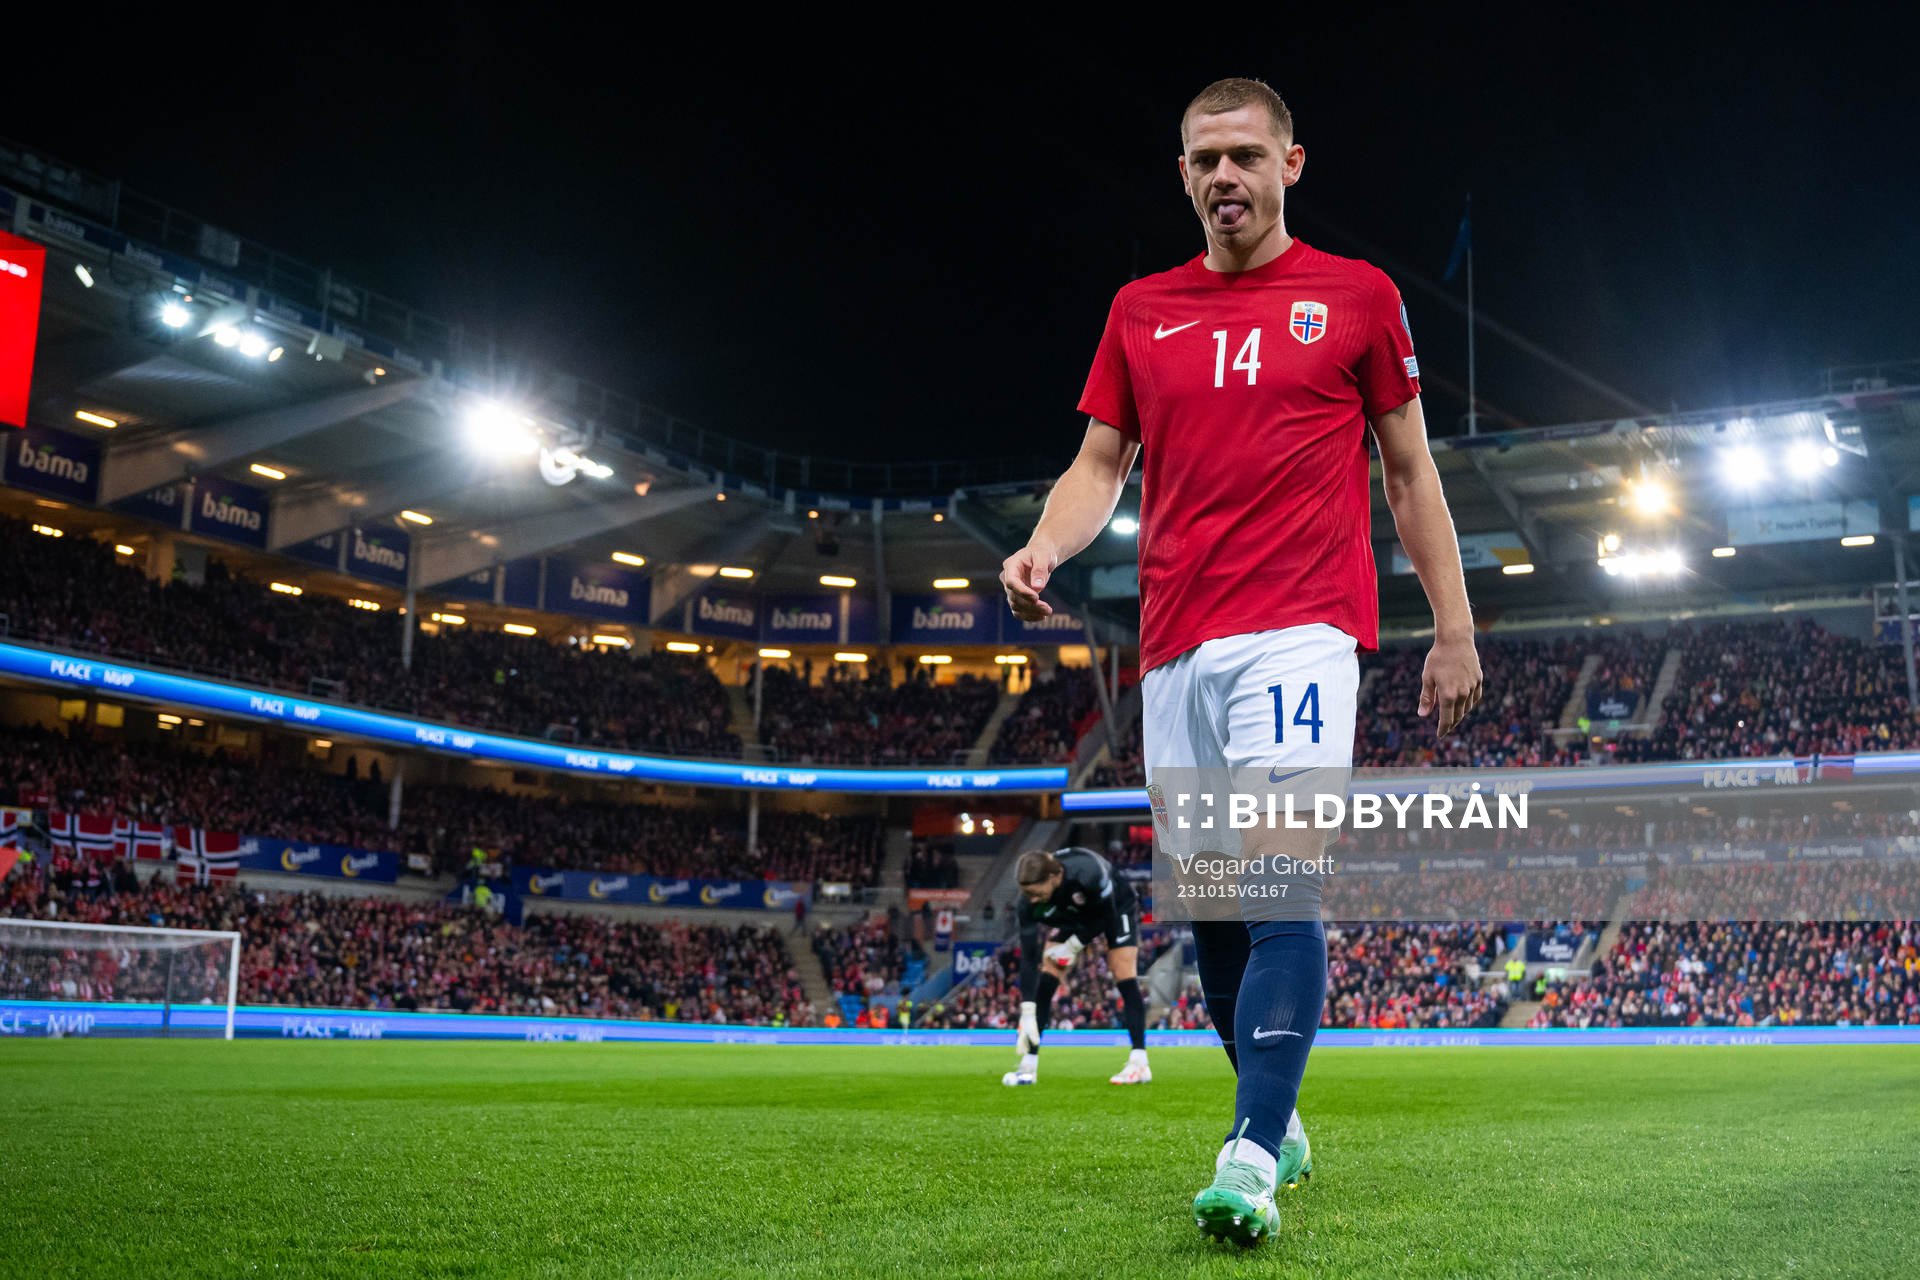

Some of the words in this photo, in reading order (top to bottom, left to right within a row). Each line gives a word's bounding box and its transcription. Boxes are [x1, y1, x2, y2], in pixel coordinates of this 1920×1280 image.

[1212, 328, 1261, 388] 14
[18, 439, 88, 484] bama
[202, 492, 261, 531] bama
[355, 536, 405, 571] bama
[571, 577, 629, 607] bama
[701, 596, 754, 626] bama
[772, 608, 832, 629] bama
[913, 607, 974, 629] bama
[1267, 683, 1323, 744] 14
[1703, 768, 1759, 788] PEACE
[1121, 914, 1130, 933] 1
[956, 950, 990, 973] ba
